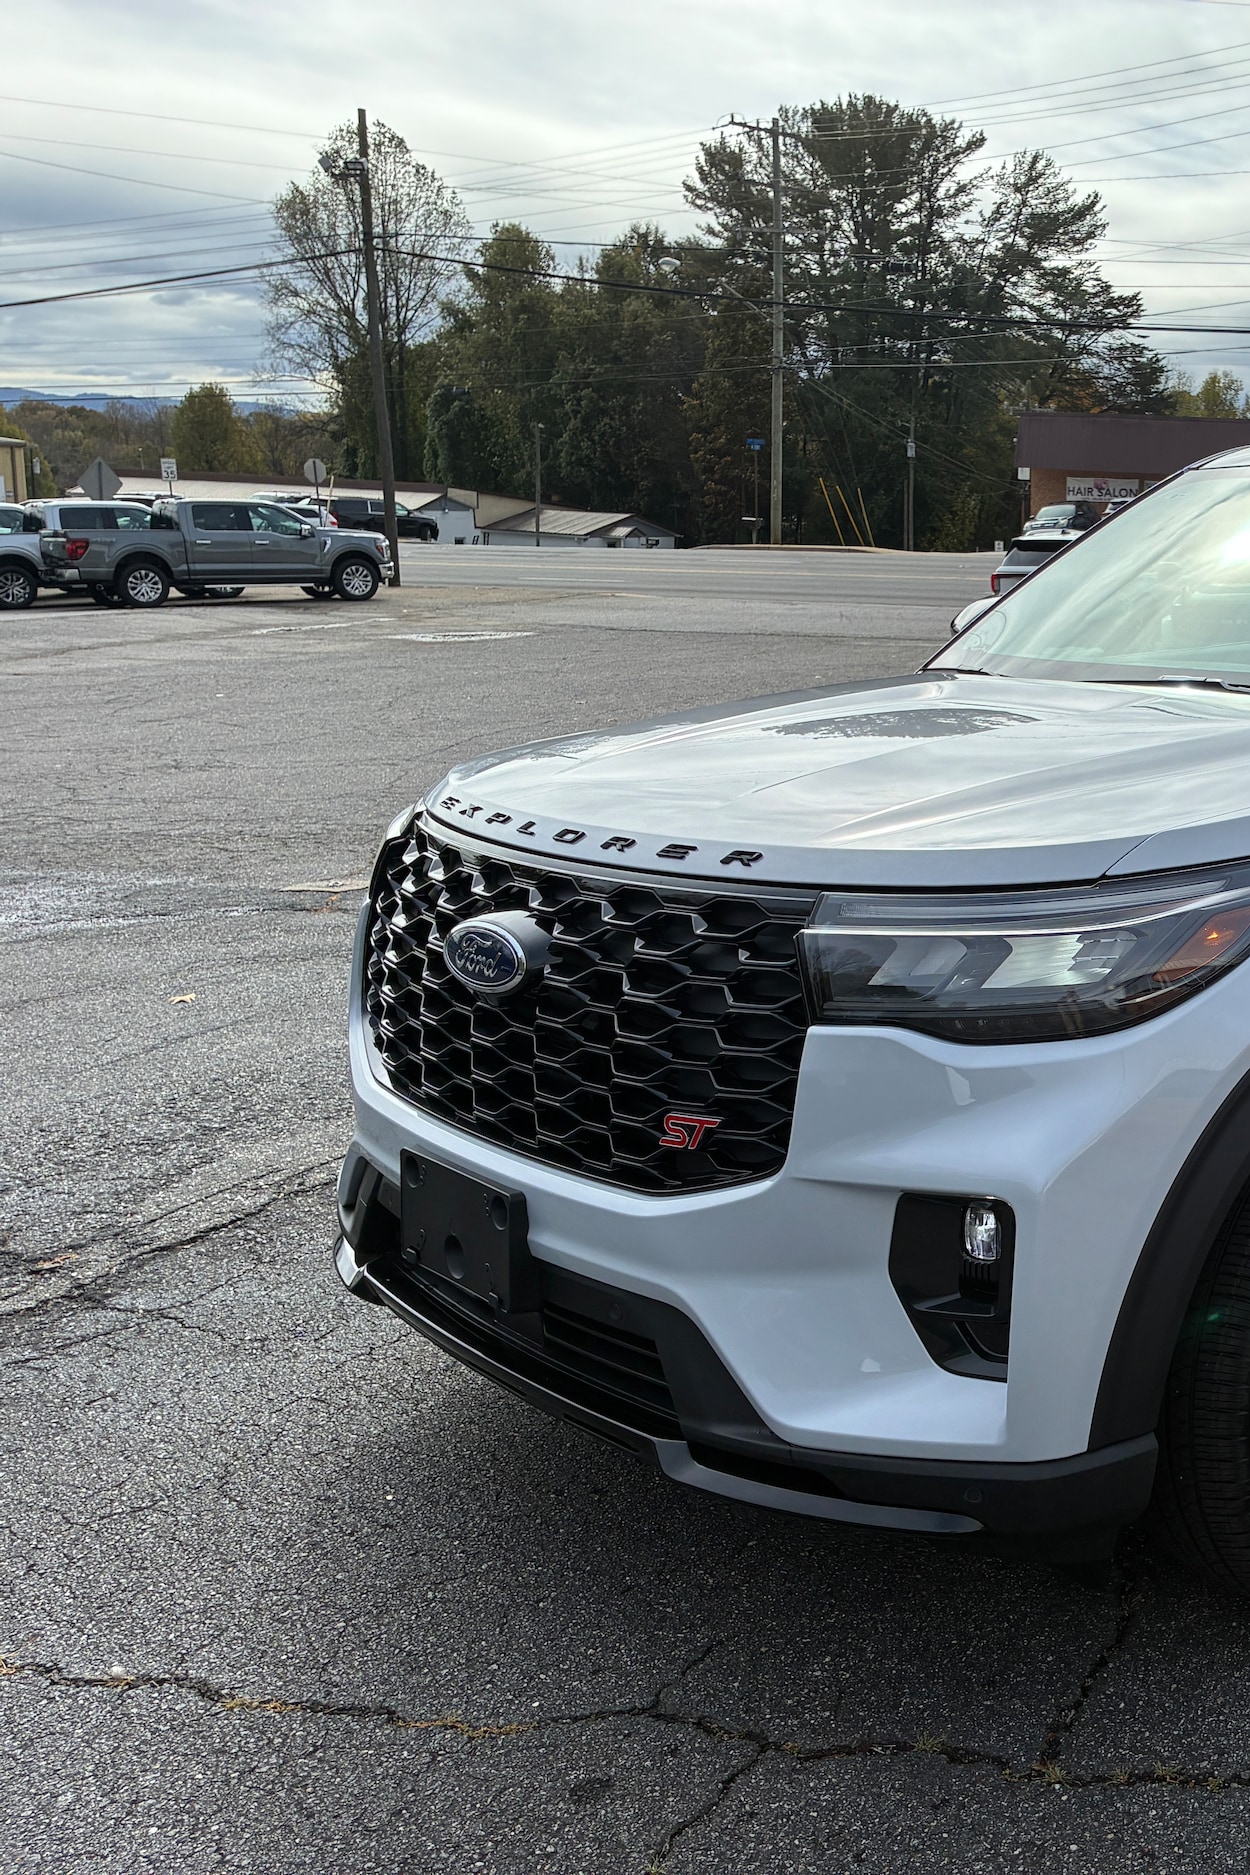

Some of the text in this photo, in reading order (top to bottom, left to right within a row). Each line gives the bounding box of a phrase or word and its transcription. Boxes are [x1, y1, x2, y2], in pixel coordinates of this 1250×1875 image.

[164, 470, 176, 479] 35
[1067, 486, 1139, 498] HAIR SALON
[438, 795, 765, 868] EXPLORER
[455, 934, 501, 978] Ford
[659, 1113, 722, 1150] ST
